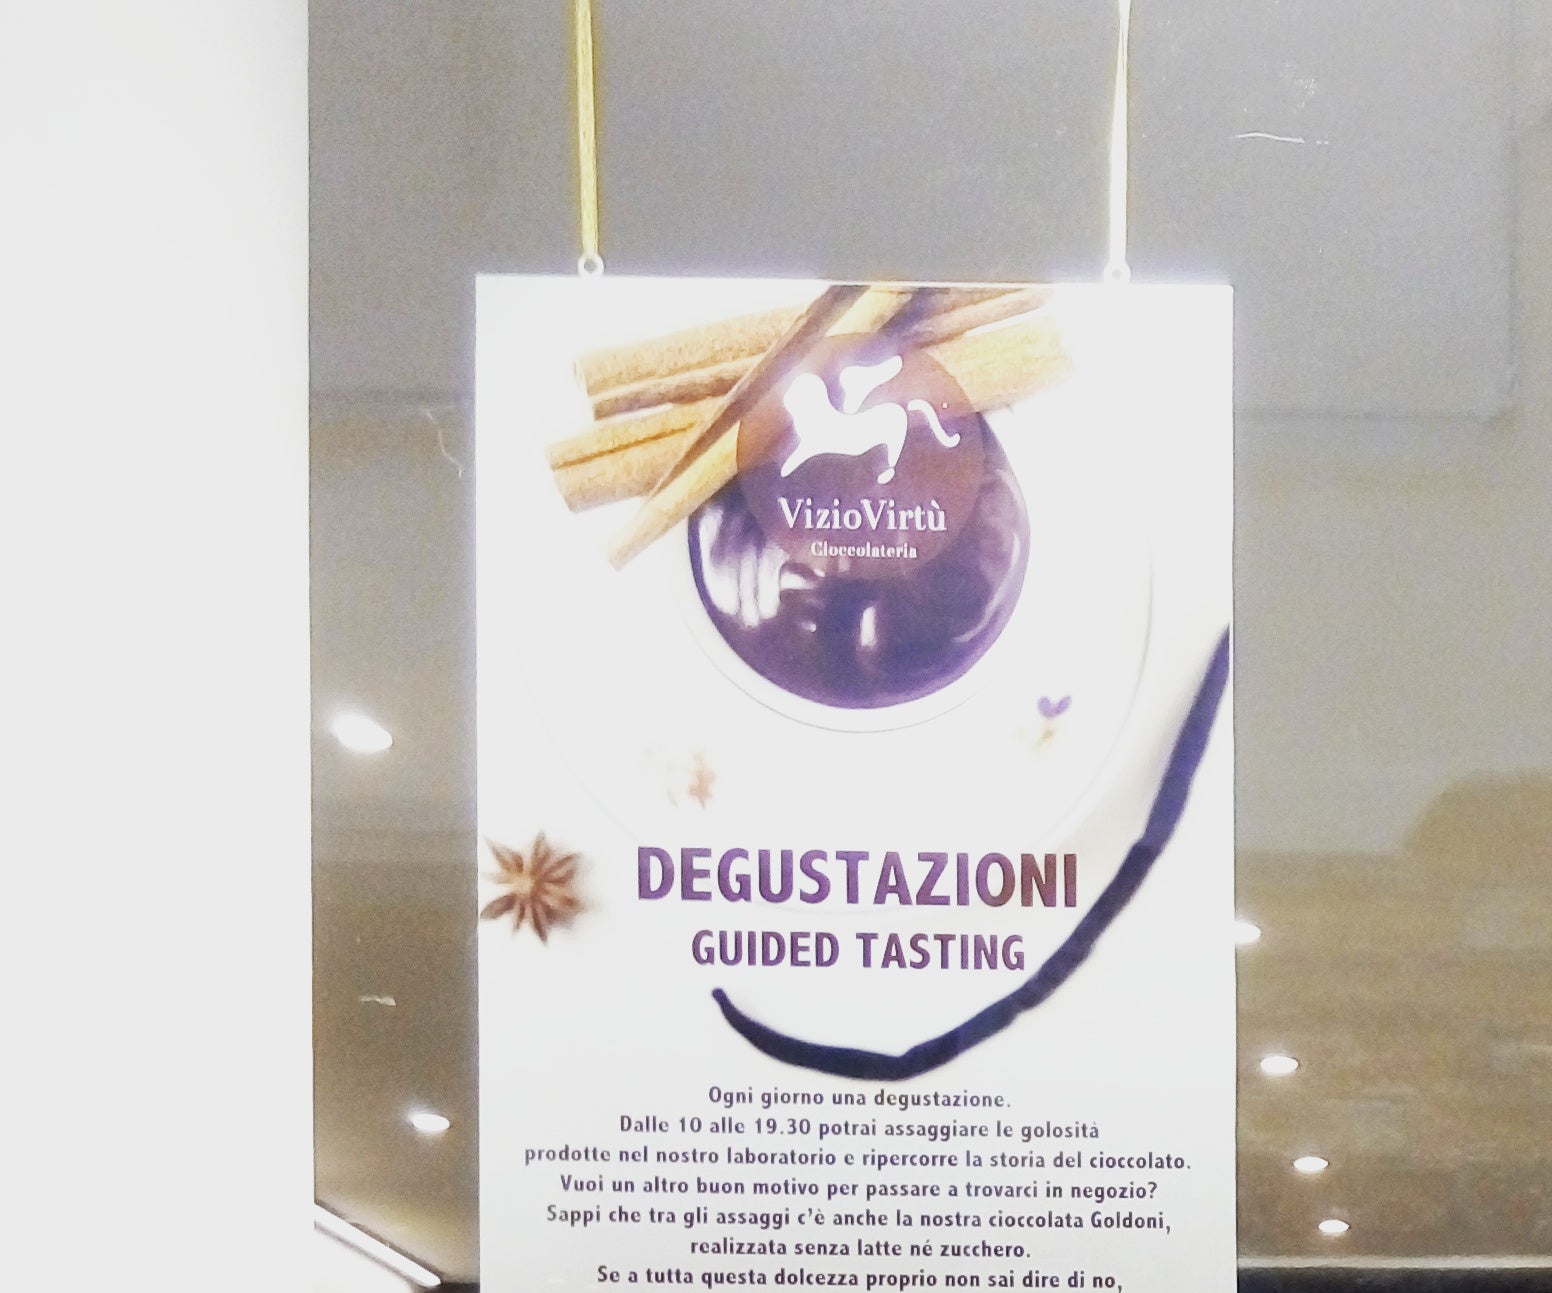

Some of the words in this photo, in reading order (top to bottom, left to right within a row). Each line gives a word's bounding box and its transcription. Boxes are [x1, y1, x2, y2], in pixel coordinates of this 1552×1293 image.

[778, 496, 946, 531] VizioVirtù
[810, 541, 918, 559] Cioccolateria
[637, 846, 1078, 908] DEGUSTAZIONI
[691, 929, 840, 968] GUIDED
[855, 932, 1025, 971] TASTING
[708, 1085, 753, 1109] Ogni
[760, 1086, 825, 1110] giorno
[832, 1093, 867, 1106] una
[873, 1089, 1011, 1112] degustazione.
[620, 1114, 669, 1133] Dalle
[679, 1116, 703, 1134] 10
[709, 1116, 745, 1135] alle
[754, 1117, 811, 1135] 19.30
[818, 1118, 877, 1141] potrai
[884, 1119, 989, 1143] assaggiare
[996, 1119, 1014, 1138] le
[1020, 1119, 1100, 1144] golosità
[524, 1143, 611, 1168] prodotte
[618, 1145, 649, 1164] nel
[656, 1147, 720, 1164] nostro
[727, 1146, 837, 1166] laboratorio
[843, 1153, 855, 1166] e
[862, 1149, 958, 1173] ripercorre
[965, 1149, 983, 1168] la
[989, 1150, 1046, 1168] storia
[1052, 1149, 1082, 1169] del
[1089, 1150, 1191, 1170] cioccolato.
[560, 1173, 604, 1192] Vuoi
[611, 1180, 635, 1194] un
[642, 1175, 689, 1194] altro
[696, 1177, 745, 1195] buon
[752, 1177, 820, 1196] motivo
[827, 1183, 859, 1201] per
[866, 1184, 941, 1203] passare
[947, 1184, 959, 1197] a
[965, 1180, 1038, 1199] trovarci
[1045, 1180, 1063, 1199] in
[1070, 1181, 1158, 1204] negozio?
[546, 1204, 601, 1228] Sappi
[608, 1206, 641, 1224] che
[648, 1207, 676, 1224] tra
[683, 1206, 708, 1230] gli
[716, 1207, 790, 1231] assaggi
[832, 1208, 889, 1227] anche
[896, 1208, 913, 1227] la
[920, 1211, 982, 1228] nostra
[988, 1209, 1084, 1229] cioccolata
[1090, 1210, 1171, 1234] Goldoni,
[690, 1236, 787, 1256] realizzata
[793, 1243, 850, 1257] senza
[857, 1238, 903, 1257] latte
[909, 1239, 933, 1257] né
[939, 1239, 1031, 1258] zucchero.
[597, 1264, 621, 1284] Se
[627, 1270, 639, 1284] a
[645, 1267, 694, 1285] tutta
[700, 1268, 767, 1291] questa
[773, 1268, 859, 1287] dolcezza
[866, 1268, 938, 1293] proprio
[944, 1274, 981, 1288] non
[987, 1269, 1015, 1288] sai
[1021, 1269, 1060, 1289] dire
[1067, 1269, 1085, 1289] di
